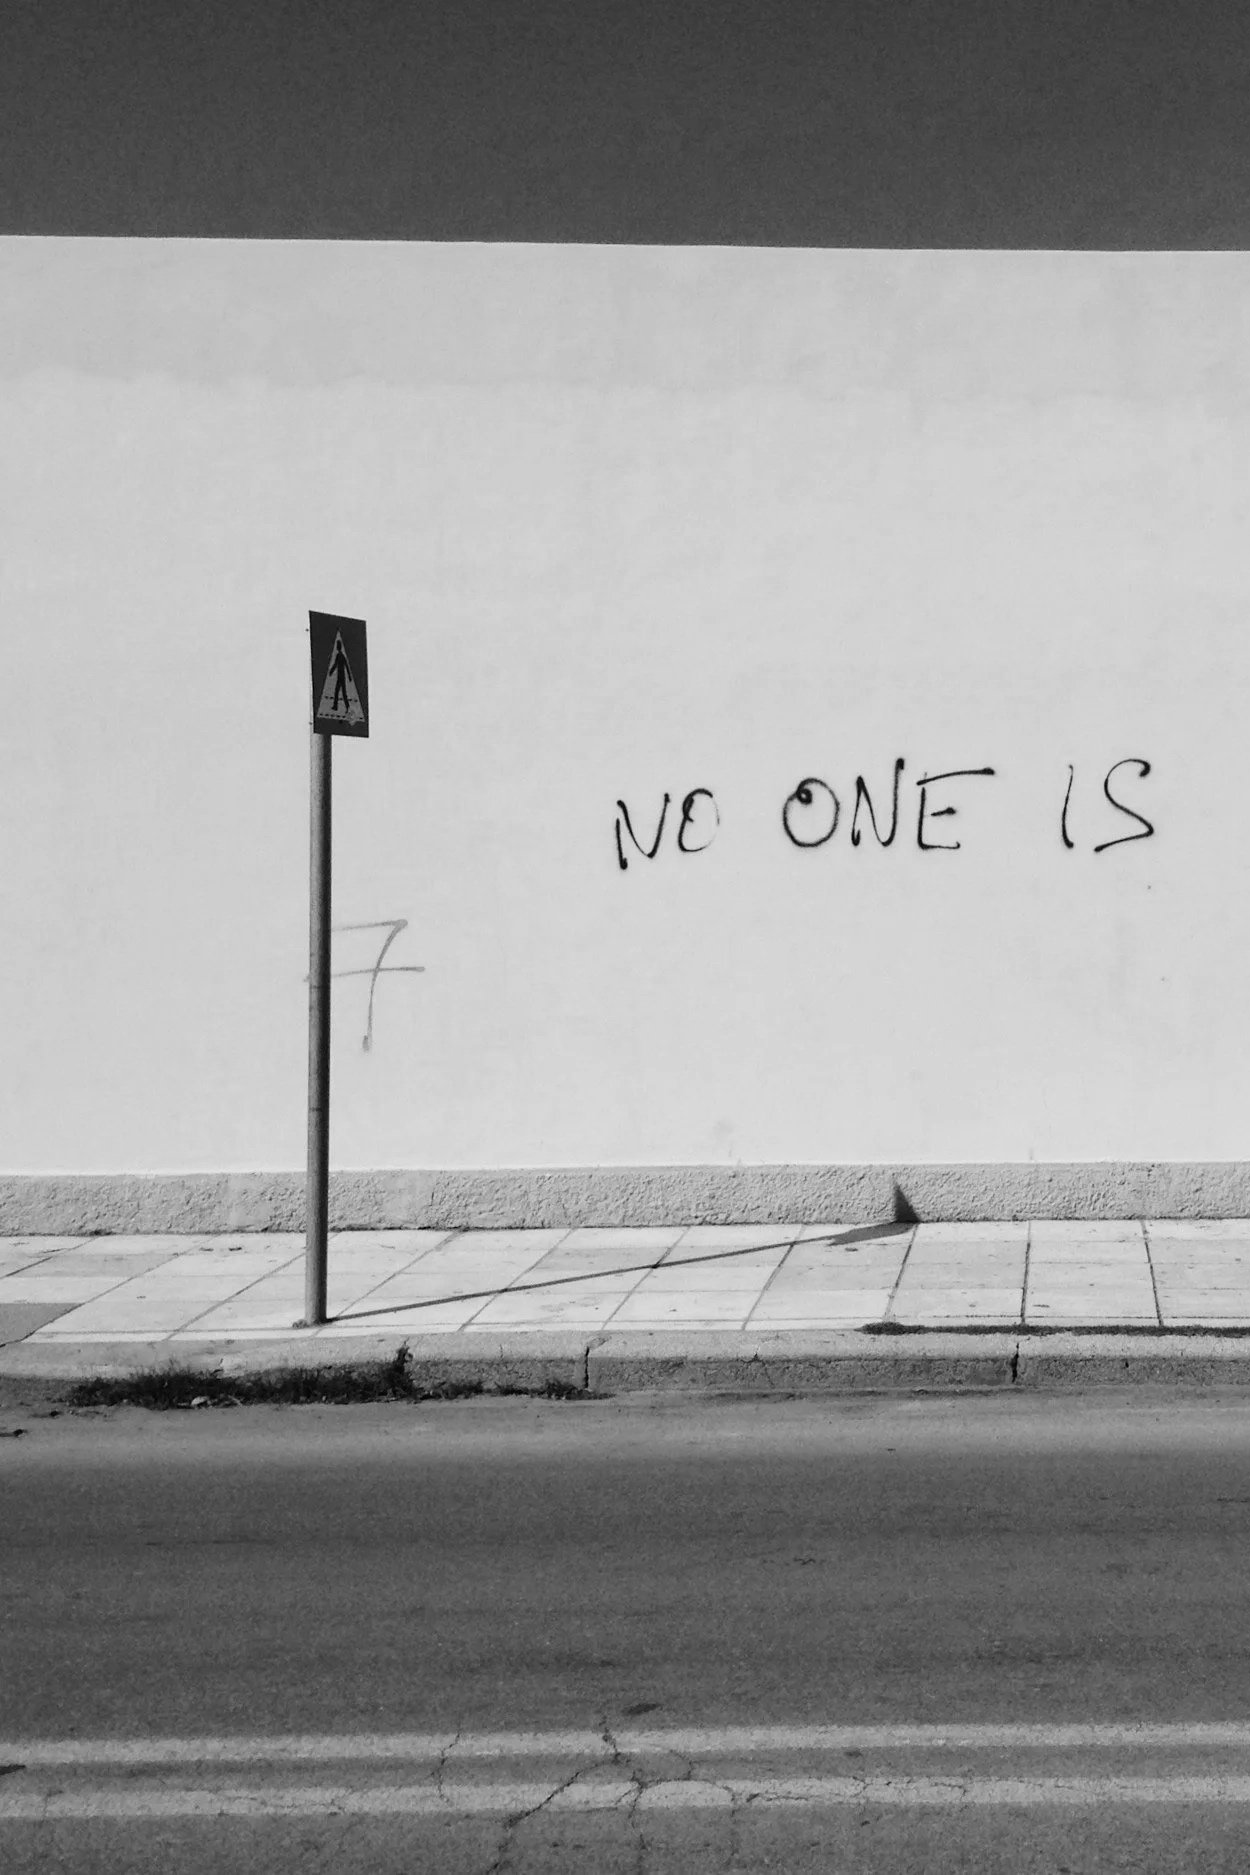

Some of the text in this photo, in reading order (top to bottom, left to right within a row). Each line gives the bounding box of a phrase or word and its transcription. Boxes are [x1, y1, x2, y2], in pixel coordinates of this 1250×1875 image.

[615, 787, 722, 871] NO
[783, 757, 996, 853] ONE
[1062, 757, 1156, 854] IS
